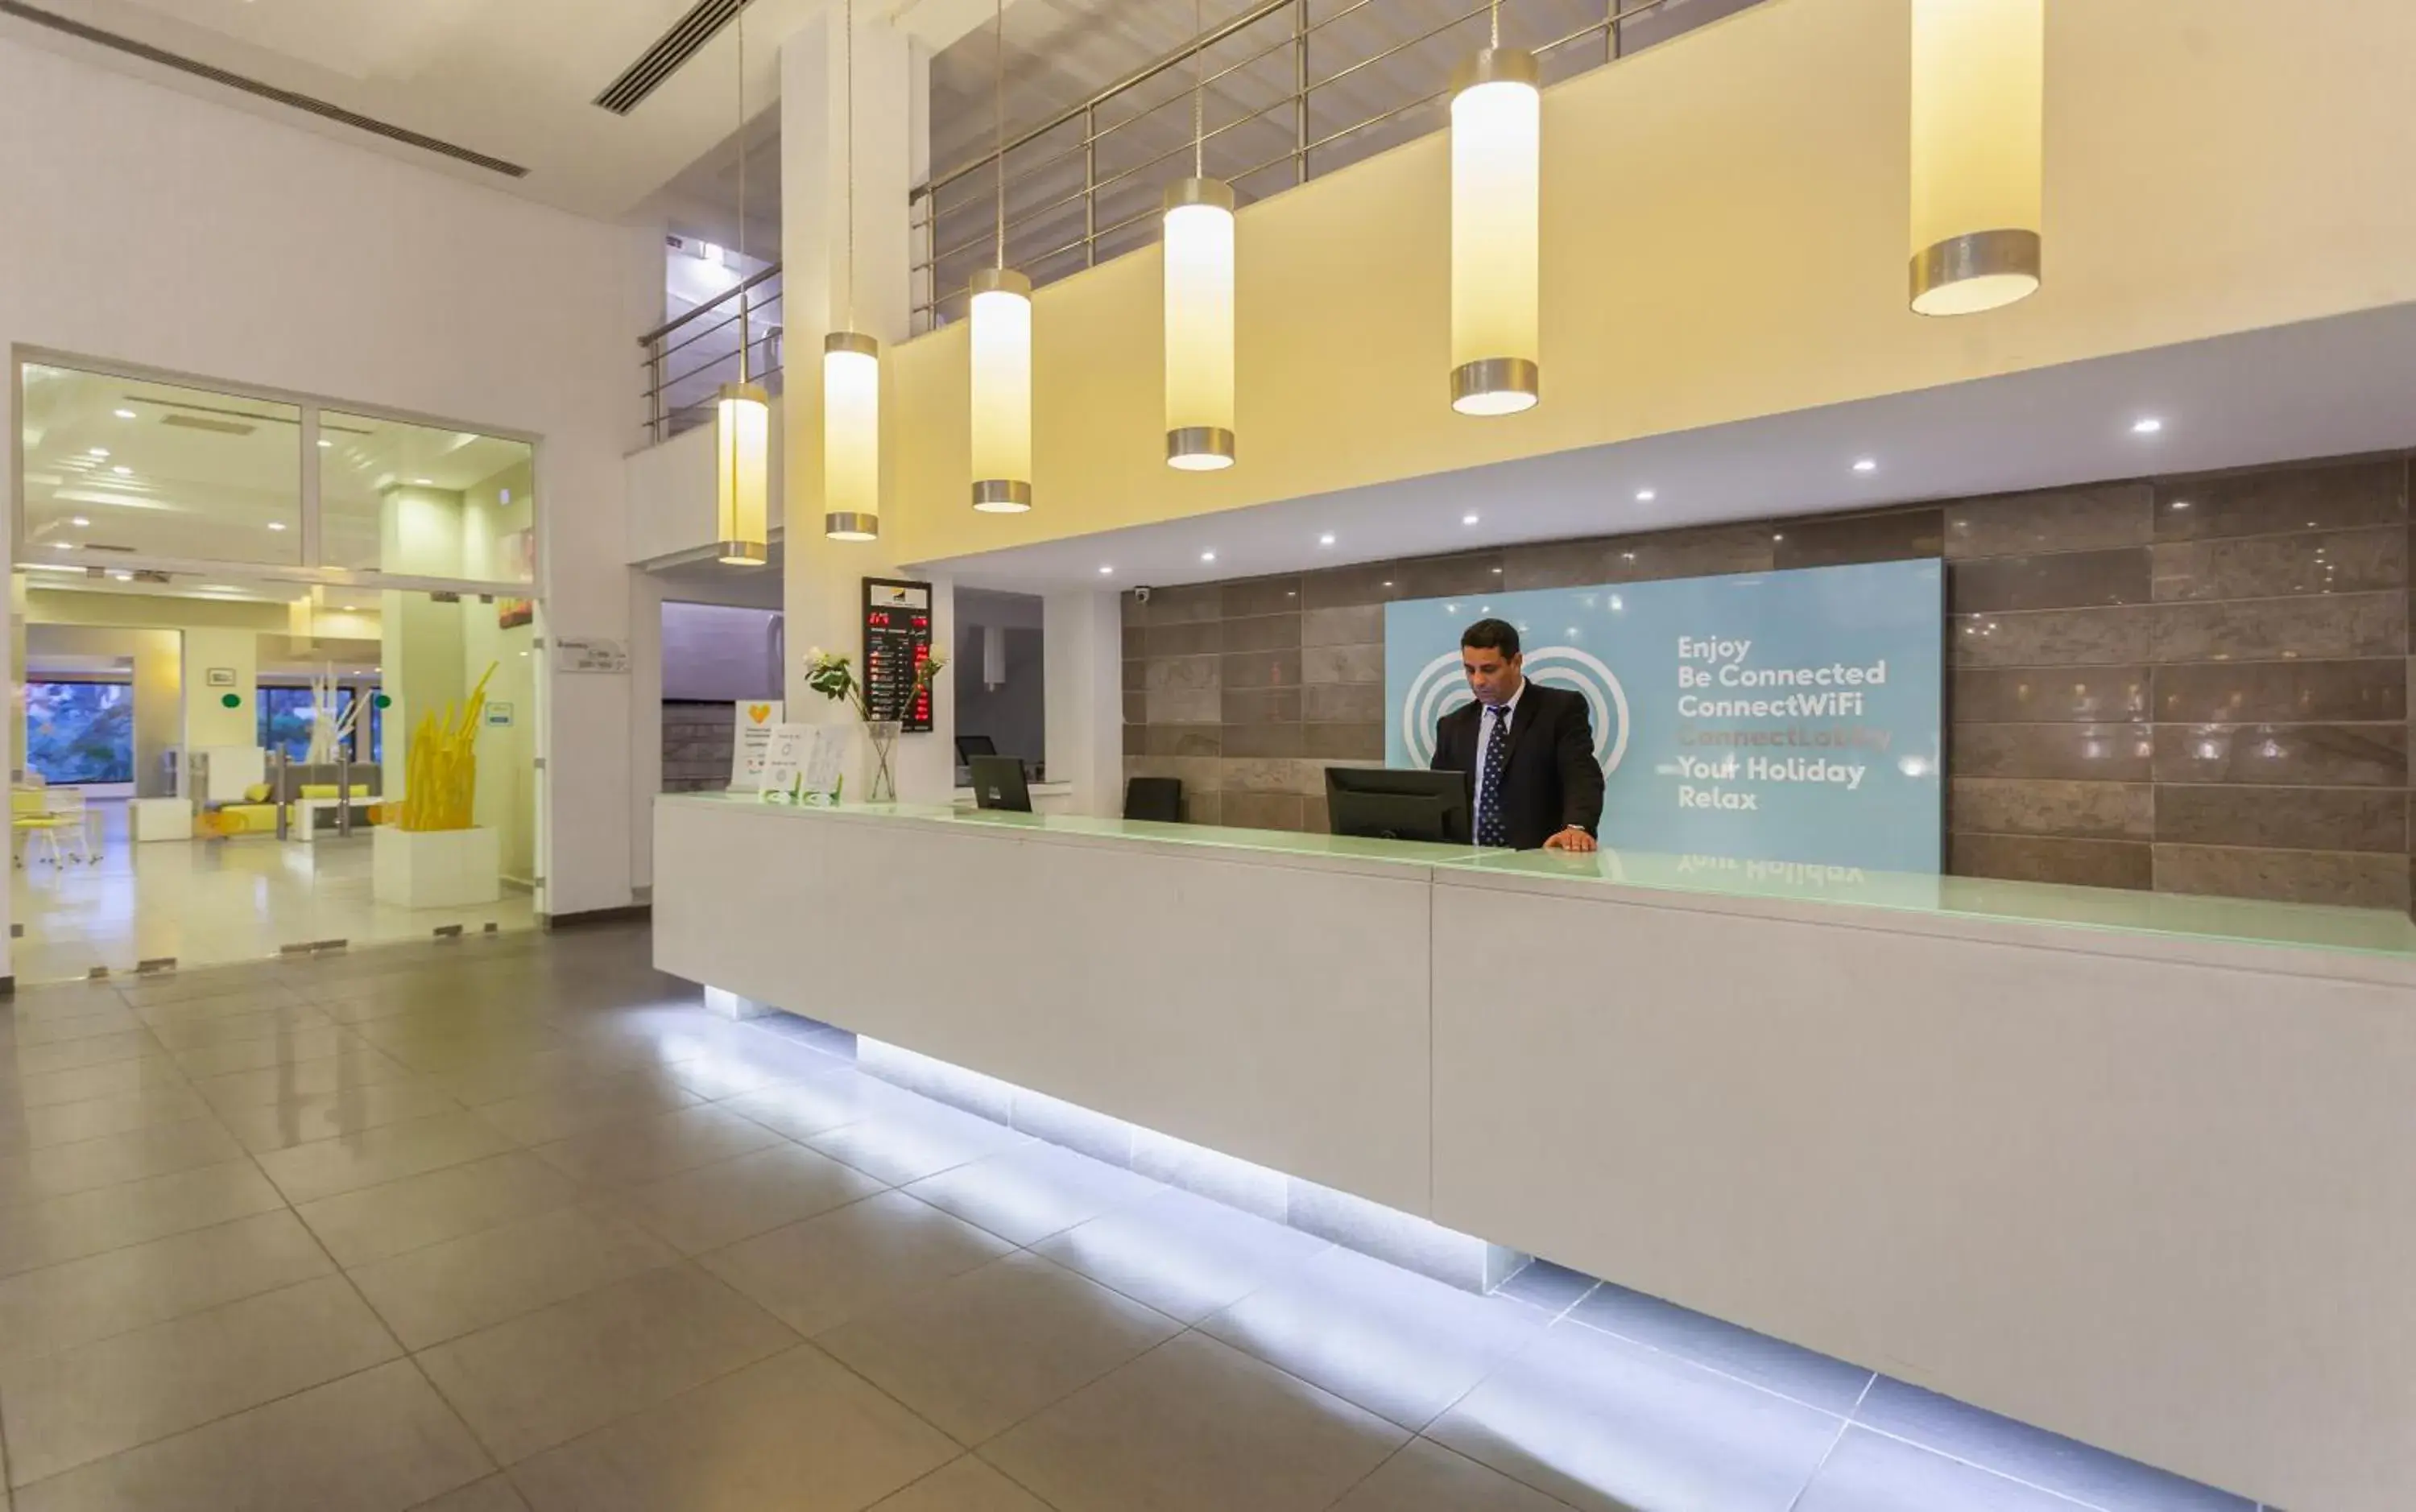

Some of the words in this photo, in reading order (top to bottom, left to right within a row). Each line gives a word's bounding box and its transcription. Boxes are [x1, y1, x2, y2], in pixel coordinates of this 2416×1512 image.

[1678, 635, 1752, 663] Enjoy
[1678, 666, 1712, 688] Be
[1719, 659, 1886, 688] Connected
[1678, 692, 1864, 717] ConnectWiFi
[1678, 755, 1740, 780] Your
[1747, 756, 1866, 791] Holiday
[1678, 785, 1759, 811] Relax
